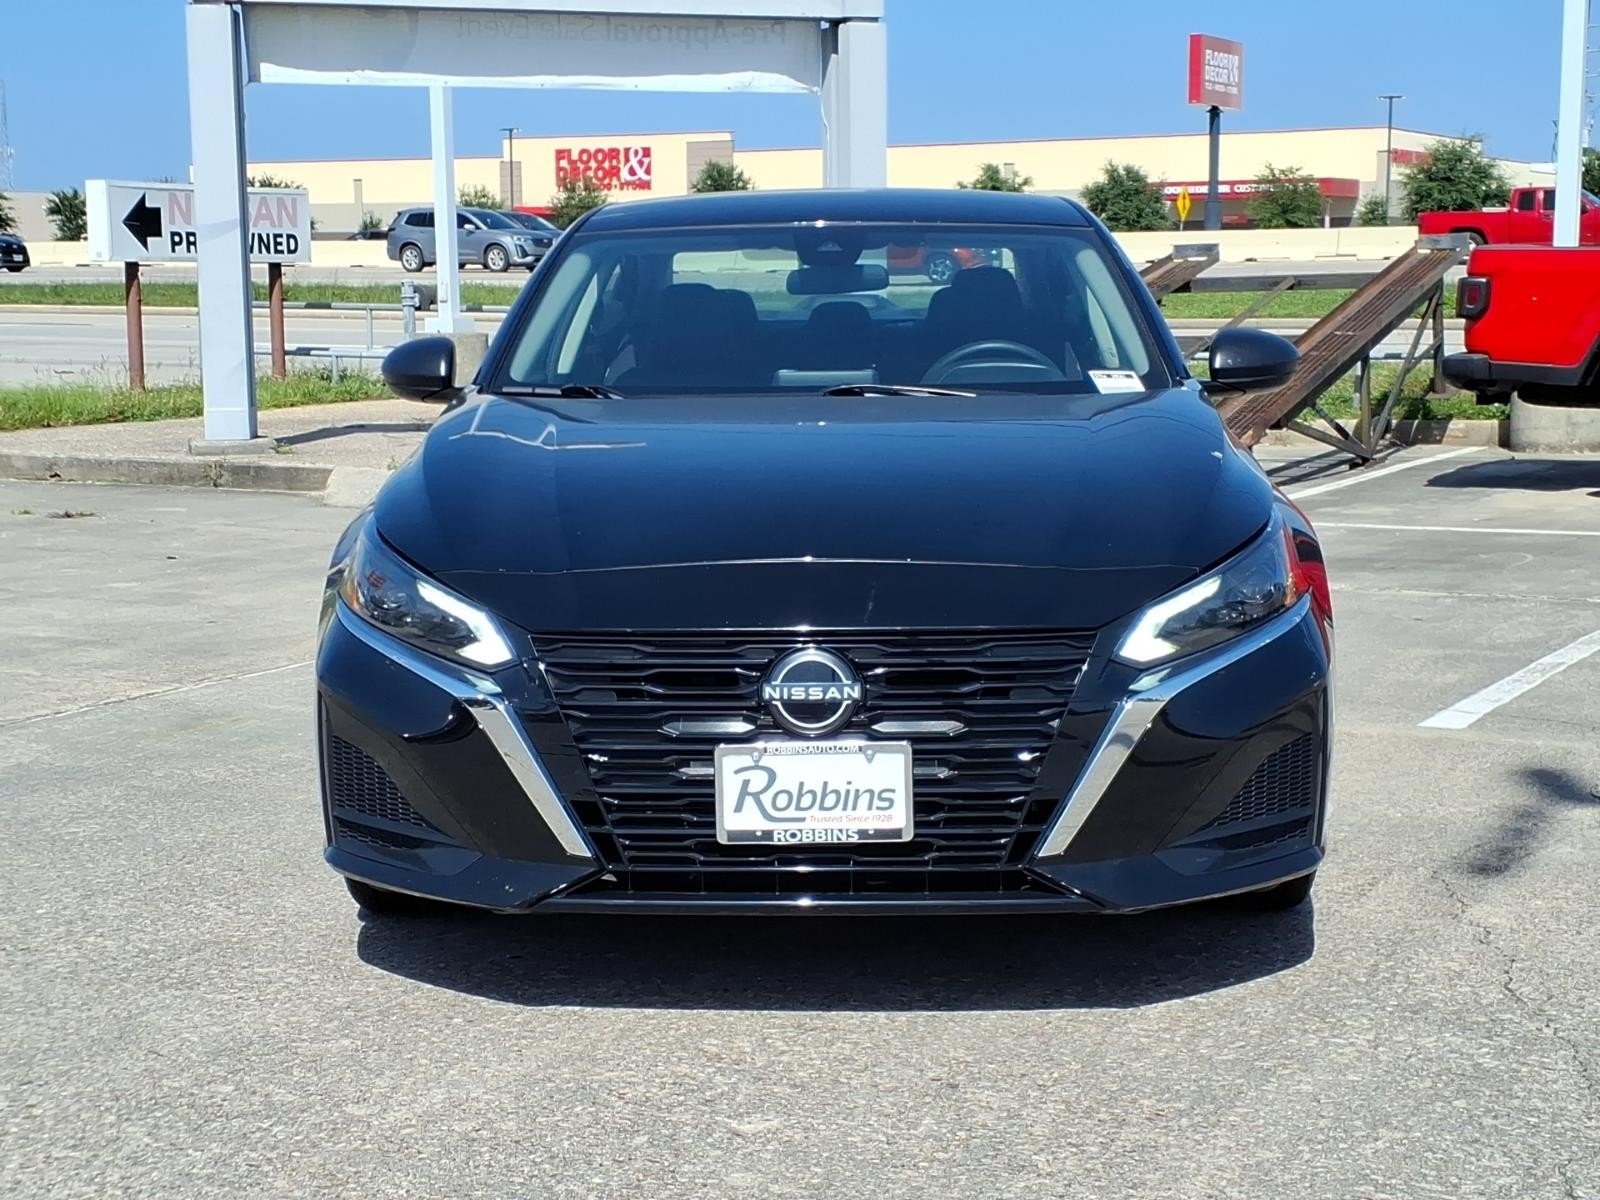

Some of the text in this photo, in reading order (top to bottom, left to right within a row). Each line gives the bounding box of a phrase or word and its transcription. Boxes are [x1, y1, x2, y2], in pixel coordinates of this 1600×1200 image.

[555, 148, 620, 166] FLOOR
[168, 192, 298, 228] NAN
[764, 685, 860, 700] NISSAN
[766, 745, 860, 754] ROBBINSAUTO.COM
[733, 764, 896, 823] Robbins
[809, 814, 893, 823] Trusted Since 1928
[773, 828, 859, 842] ROBBINS
